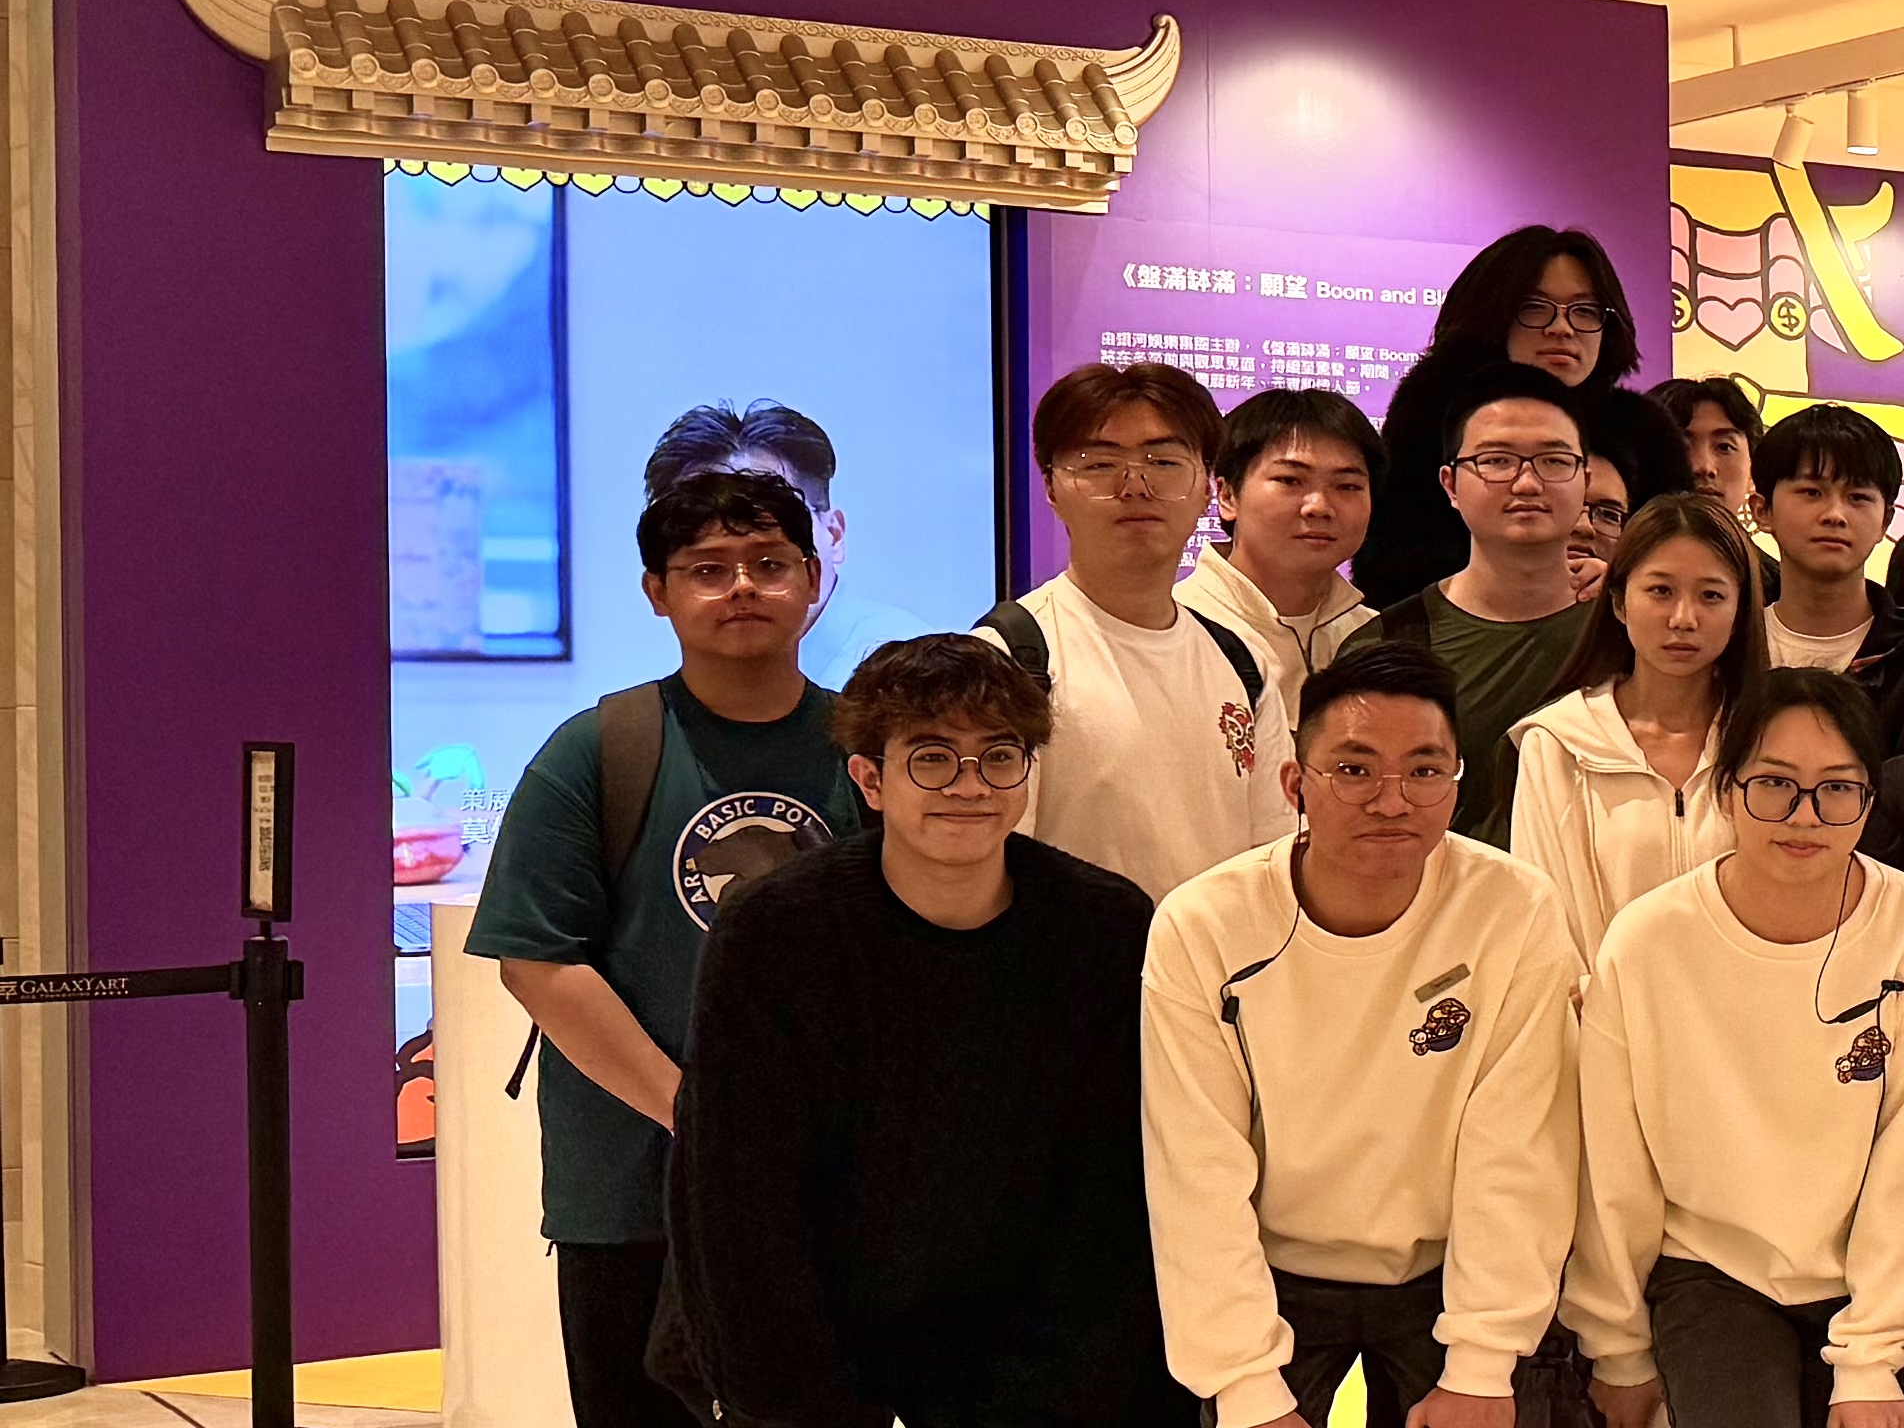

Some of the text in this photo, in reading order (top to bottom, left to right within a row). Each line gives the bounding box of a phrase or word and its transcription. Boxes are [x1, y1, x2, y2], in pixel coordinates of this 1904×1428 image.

[1316, 280, 1374, 303] Boom
[1380, 286, 1416, 306] and
[694, 799, 756, 840] BASIC
